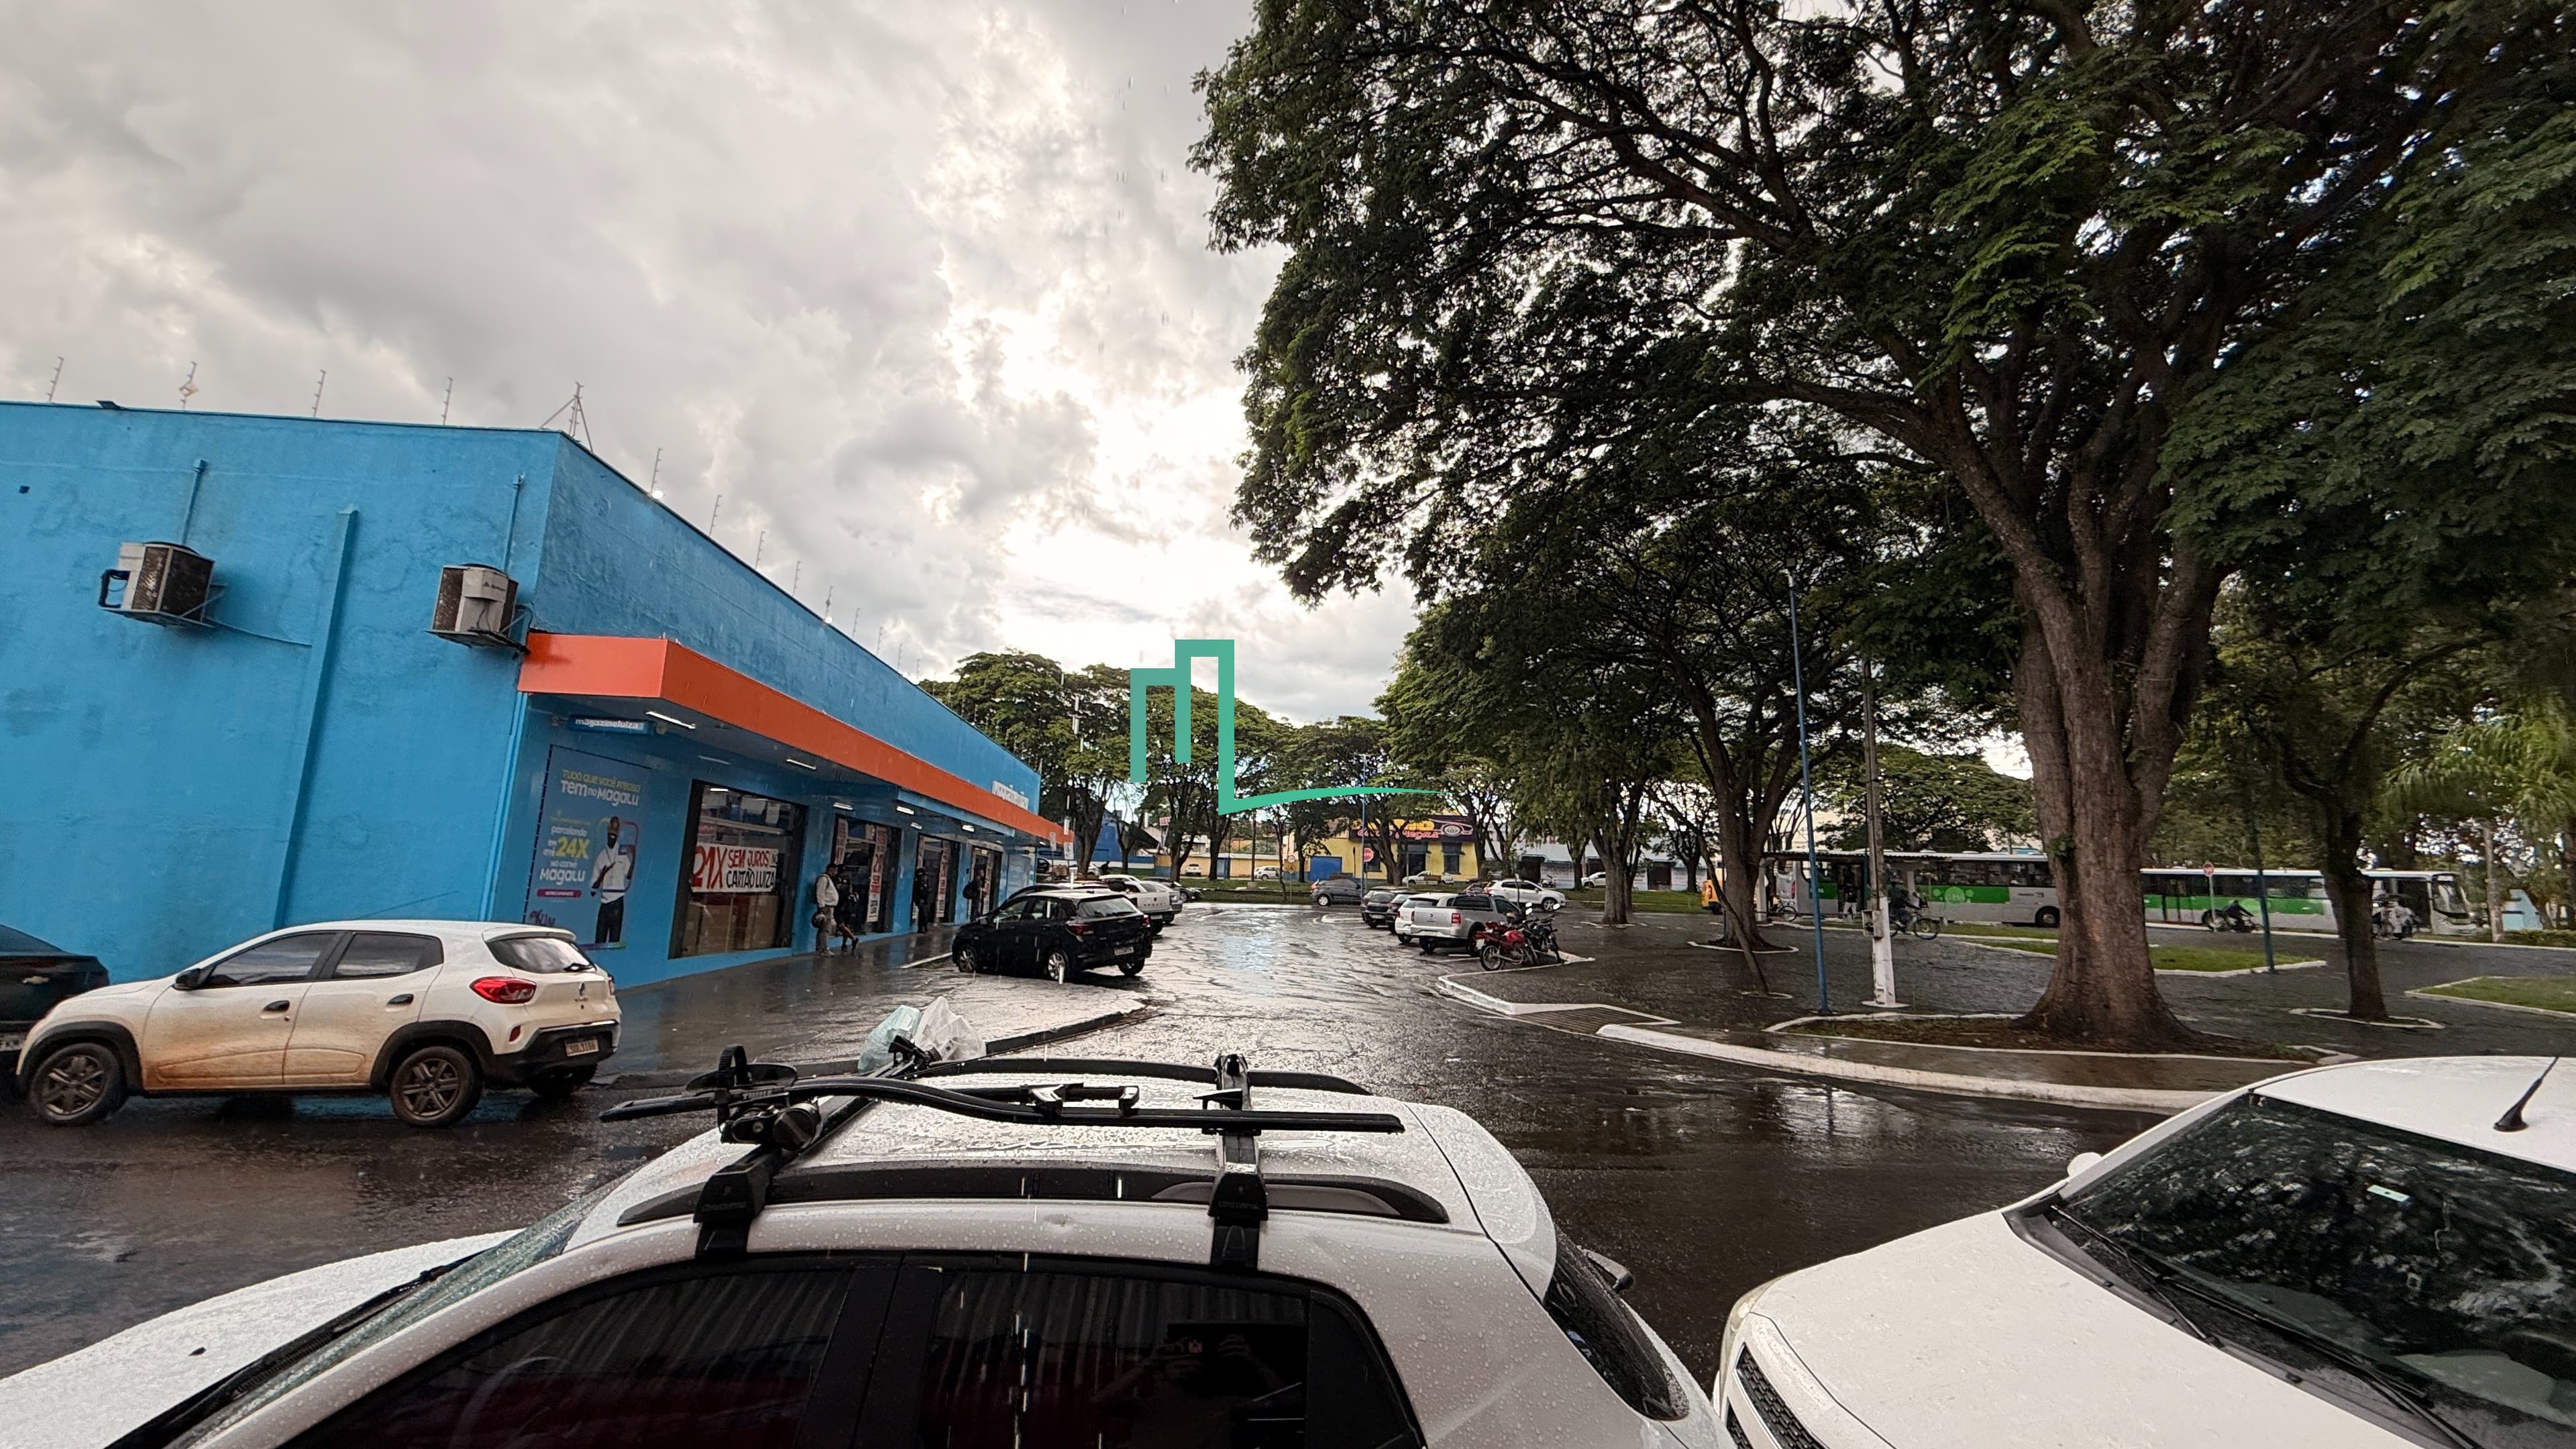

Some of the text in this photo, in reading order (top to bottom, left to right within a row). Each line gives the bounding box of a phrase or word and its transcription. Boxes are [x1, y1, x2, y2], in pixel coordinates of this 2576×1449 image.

[692, 845, 727, 889] 21X
[728, 849, 746, 868] SEM
[747, 851, 769, 867] JUROS
[755, 871, 775, 888] LUIZA
